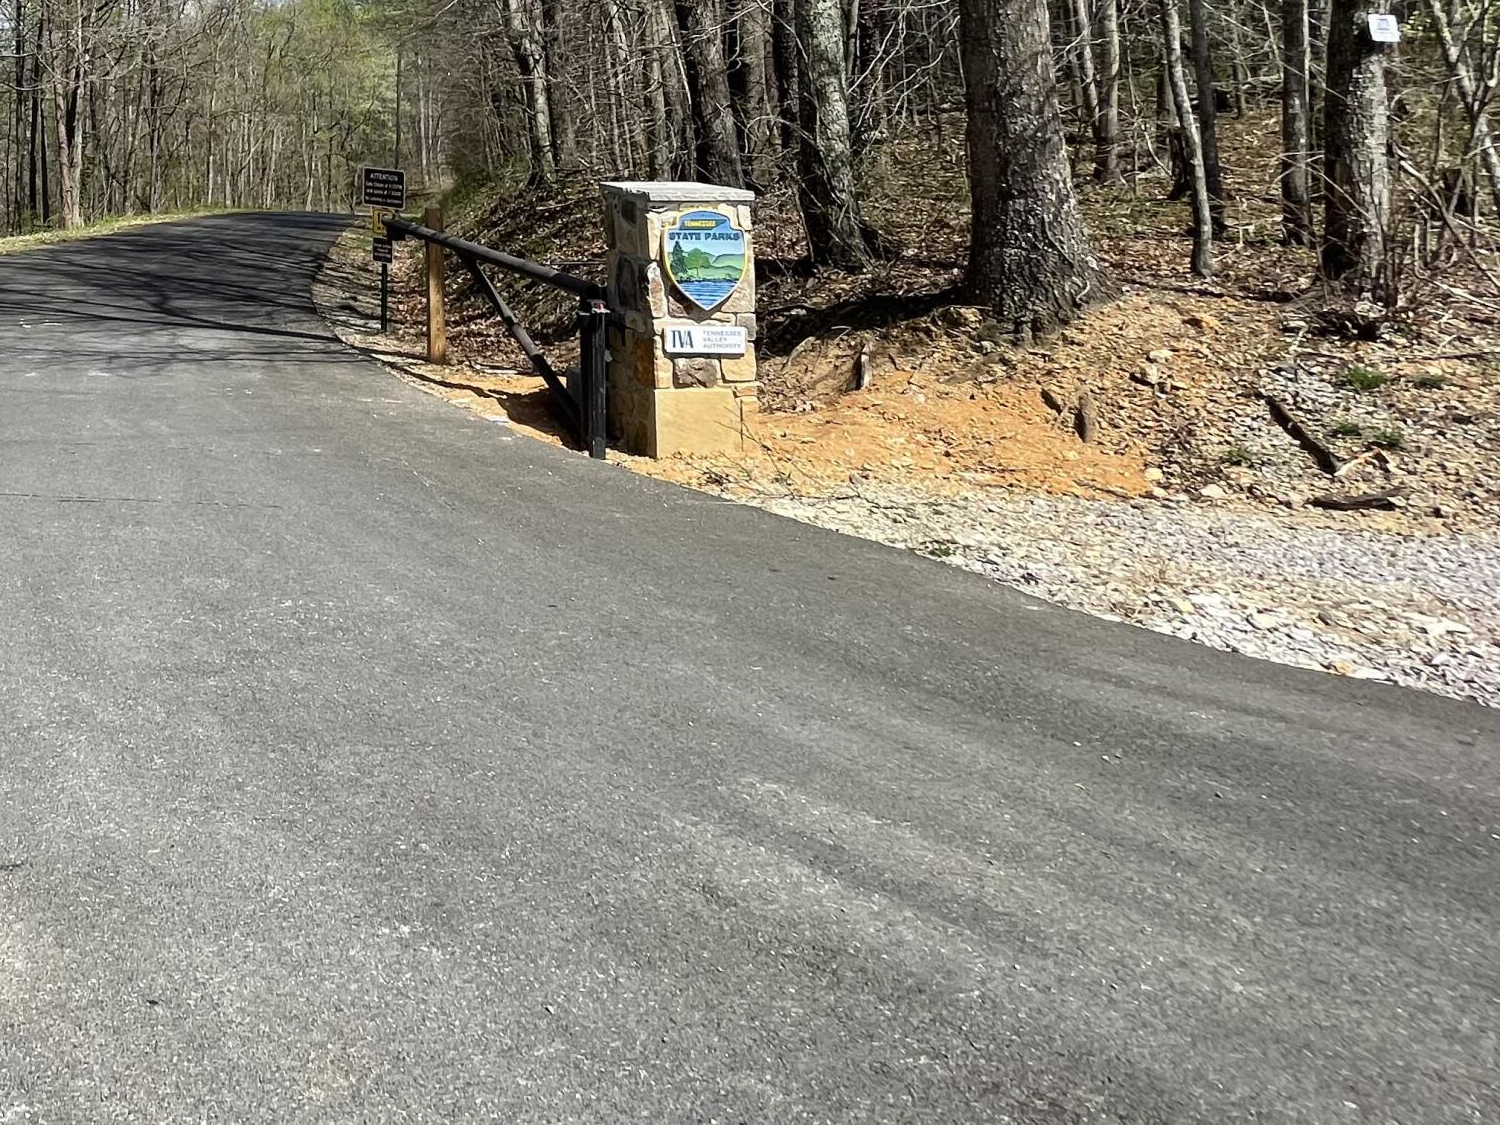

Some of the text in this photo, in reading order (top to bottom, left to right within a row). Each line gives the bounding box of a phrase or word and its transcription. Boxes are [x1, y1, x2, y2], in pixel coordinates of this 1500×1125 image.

[668, 232, 740, 241] STATE PARKS
[671, 330, 694, 349] TVA
